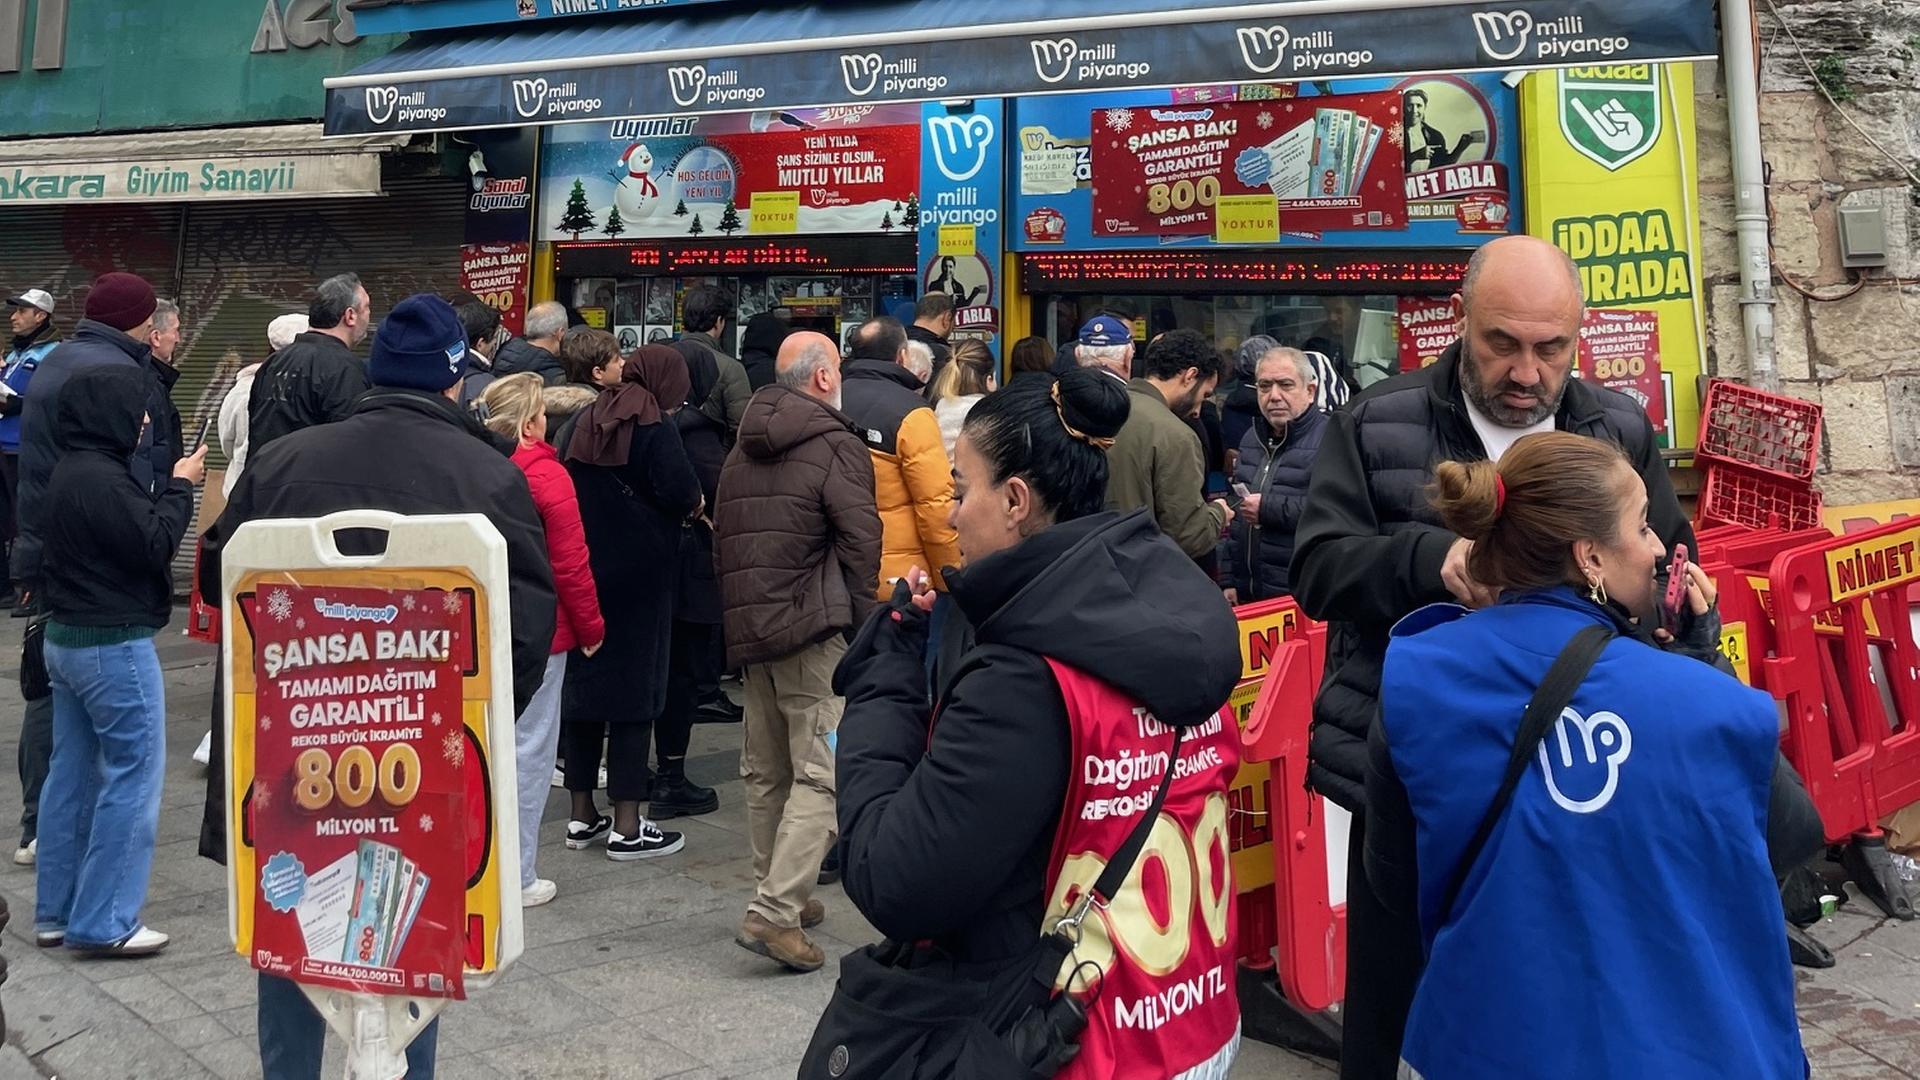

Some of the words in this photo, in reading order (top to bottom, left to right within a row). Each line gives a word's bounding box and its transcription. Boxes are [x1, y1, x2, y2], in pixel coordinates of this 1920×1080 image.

[1537, 16, 1583, 35] milli
[1292, 31, 1333, 50] milli
[1537, 36, 1629, 58] piyango
[1079, 43, 1115, 62] milli
[1293, 48, 1373, 71] piyango
[884, 58, 917, 75] milli
[1078, 60, 1150, 80] piyango
[707, 70, 738, 87] milli
[884, 74, 947, 94] piyango
[399, 92, 425, 106] milli
[549, 83, 577, 97] milli
[707, 87, 765, 103] piyango
[398, 106, 446, 122] piyango
[548, 98, 601, 114] piyango
[804, 133, 826, 149] YENİ
[829, 135, 858, 148] YILDA
[1128, 126, 1191, 153] ŞANSA
[1194, 120, 1237, 138] BAK!
[777, 154, 802, 169] ŞANS
[804, 150, 840, 165] SİZİNLE
[843, 151, 886, 164] OLSUN...
[1137, 147, 1181, 163] TAMAMI
[1183, 139, 1229, 155] DAĞITIM
[1144, 151, 1222, 176] GARANTİLİ
[127, 165, 189, 197] Giyim
[200, 162, 296, 193] Sanayii
[483, 177, 526, 194] Sanal
[778, 168, 828, 187] MUTLU
[833, 165, 884, 185] YILLAR
[1445, 165, 1496, 191] ABLA
[470, 193, 530, 212] Oyunlar
[937, 188, 977, 206] milli
[1148, 176, 1222, 214] 800
[753, 213, 795, 222] YOKTUR
[921, 206, 997, 227] piyango
[1160, 213, 1195, 227] MİLYON
[1197, 212, 1208, 221] TL
[1222, 219, 1274, 229] YOKTUR
[464, 256, 499, 273] ŞANSA
[501, 252, 527, 265] BAK!
[963, 308, 992, 324] ABLA
[1401, 306, 1455, 328] ŞANSA
[1410, 325, 1450, 336] TAMAMI
[1580, 323, 1623, 338] ŞANSA
[1625, 321, 1655, 332] BAK!
[1595, 357, 1645, 379] 800
[1836, 541, 1915, 594] NİMET
[323, 604, 345, 618] milli
[345, 604, 386, 621] piyango
[264, 630, 370, 678] ŞANSA
[376, 629, 450, 662] BAK!
[279, 675, 353, 699] TAMAMI
[357, 668, 436, 694] DAĞITIM
[290, 693, 424, 728] GARANTİLİ
[292, 734, 328, 748] REKOR
[330, 729, 368, 744] BÜYÜK
[370, 727, 423, 742] İKRAMİYE
[294, 742, 421, 811] 800
[316, 817, 375, 836] MİLYON
[380, 817, 399, 833] TL
[389, 973, 402, 983] TL
[1115, 974, 1203, 1030] MİLYON
[1207, 966, 1227, 1001] TL
